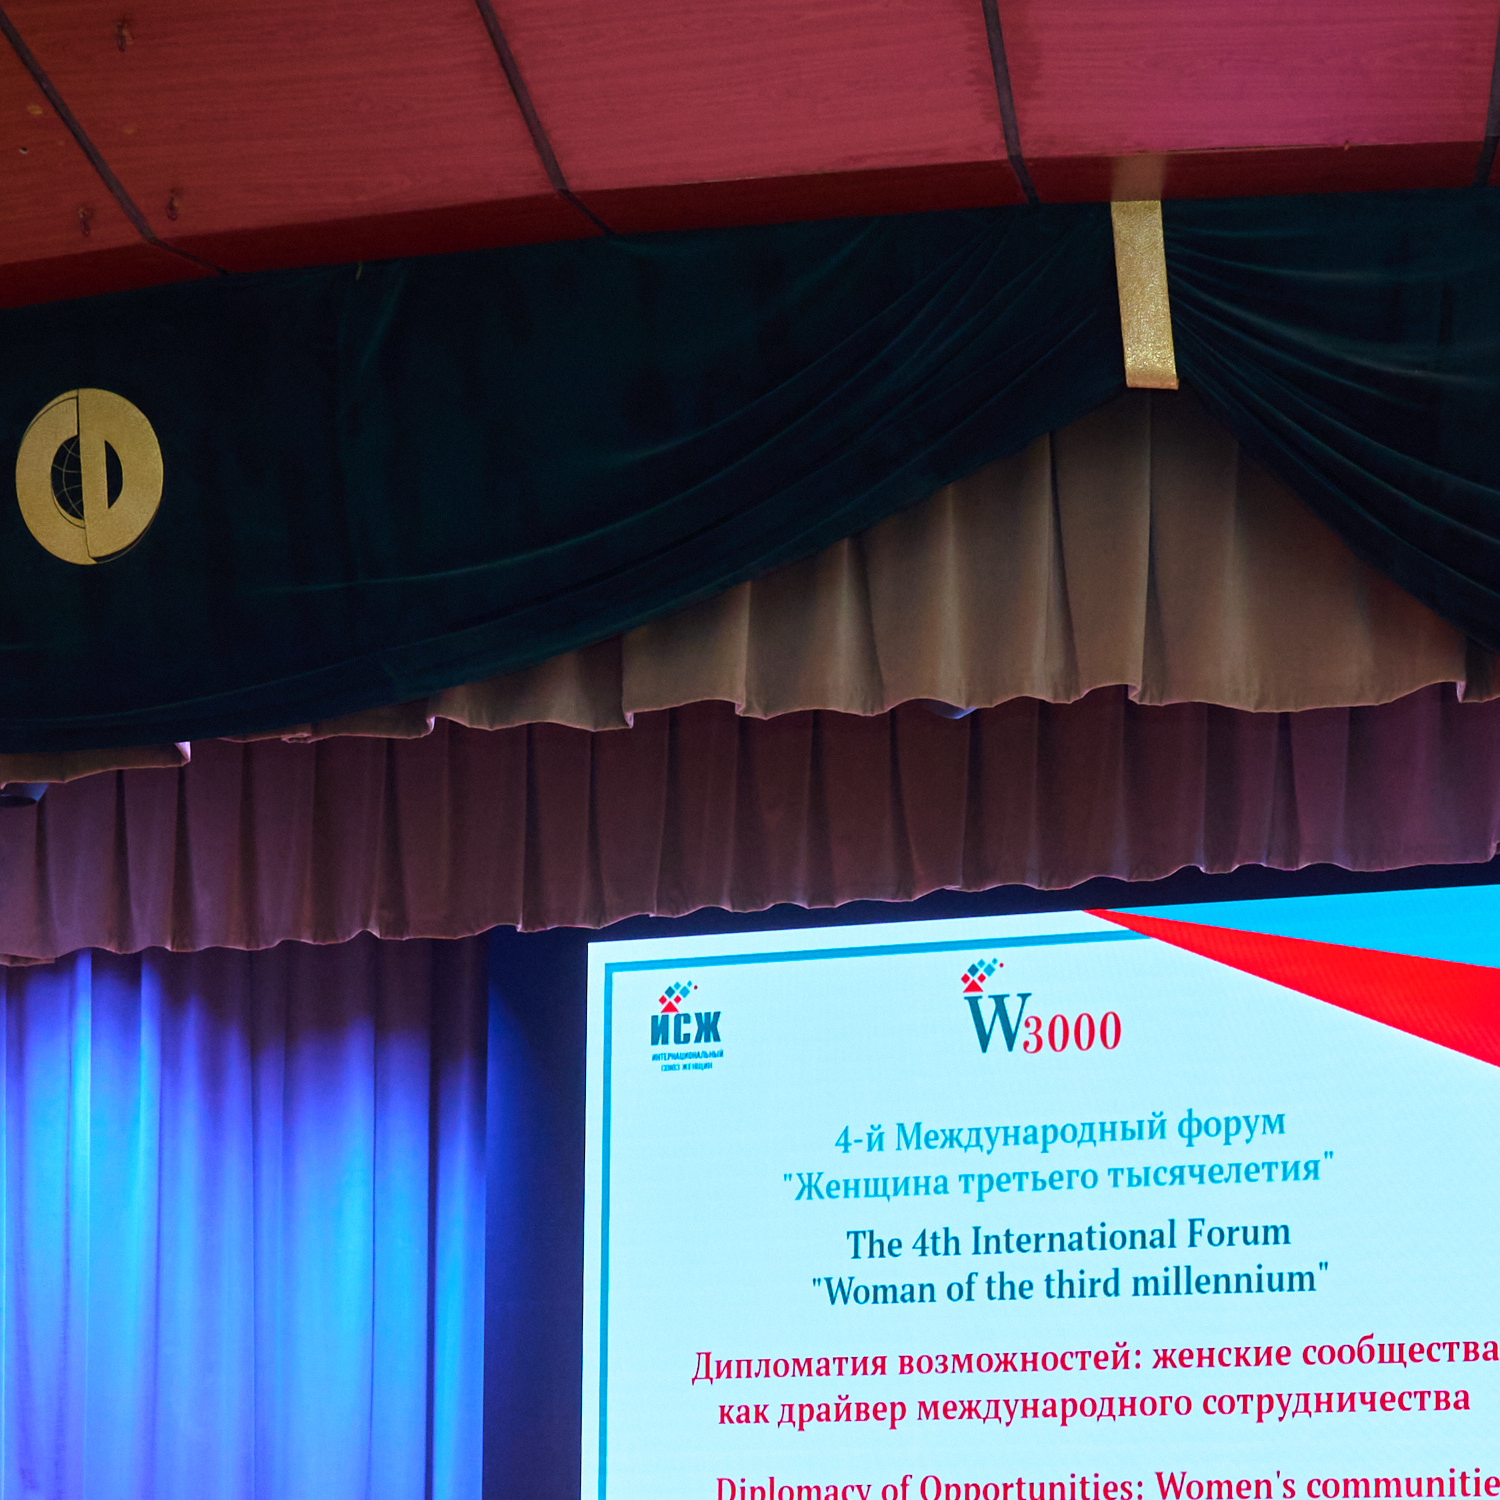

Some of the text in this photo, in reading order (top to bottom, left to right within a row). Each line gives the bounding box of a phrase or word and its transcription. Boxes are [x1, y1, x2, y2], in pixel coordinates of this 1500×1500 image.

[650, 1011, 722, 1046] ИСЖ
[963, 992, 1122, 1054] W3000
[834, 1107, 1287, 1157] 4-й Международный форум
[783, 1149, 1335, 1204] "Женщина третьего тысячелетия"
[845, 1217, 1293, 1260] The 4th International Forum
[811, 1260, 1329, 1307] "Woman of the third millennium"
[691, 1332, 1500, 1386] Дипломатия возможностей: женские сообщества
[718, 1389, 1471, 1432] как драйвер международного сотрудничества
[1154, 1470, 1296, 1500] Women's
